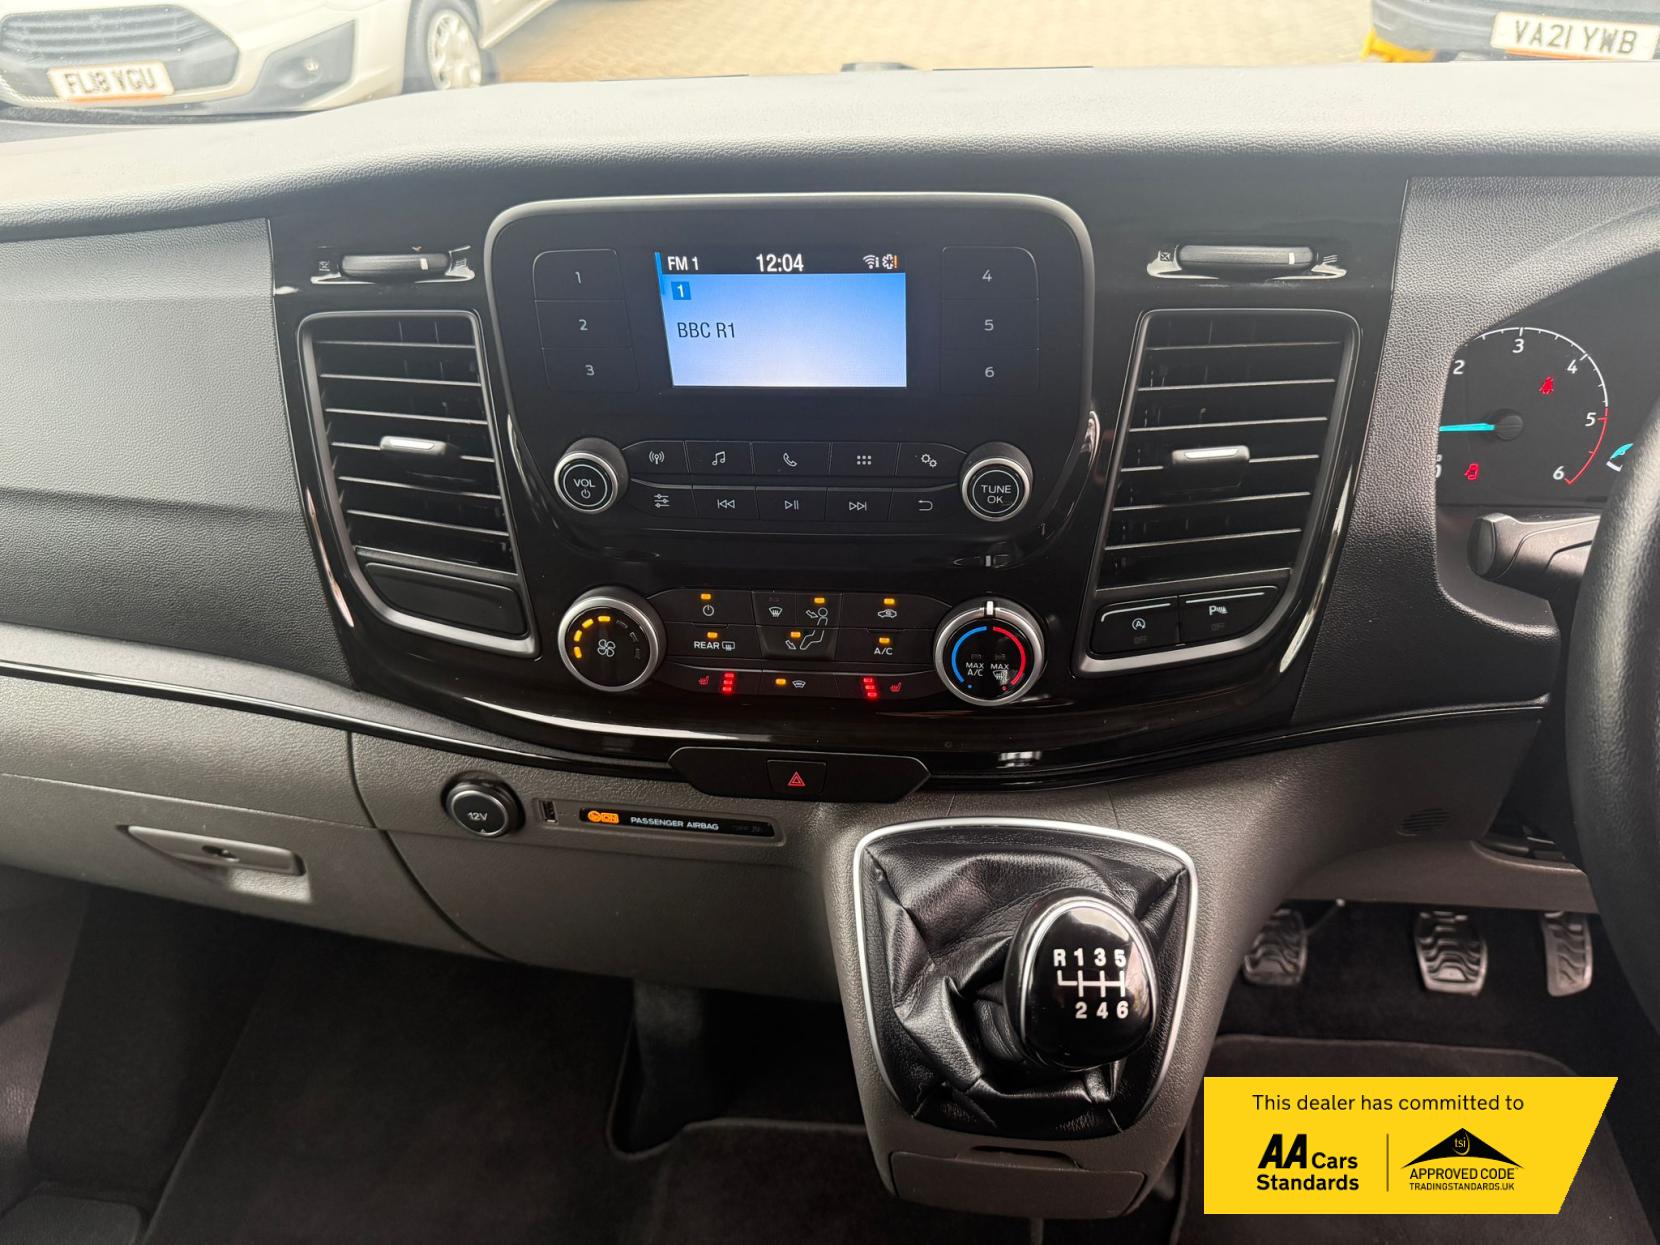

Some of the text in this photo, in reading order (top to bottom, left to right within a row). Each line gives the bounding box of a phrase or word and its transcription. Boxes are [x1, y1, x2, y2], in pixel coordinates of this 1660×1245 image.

[1515, 19, 1638, 55] VA21 YWB
[667, 255, 700, 271] FM 1
[756, 253, 804, 272] 12:04
[575, 271, 582, 284] 1
[982, 269, 993, 282] 4
[677, 283, 685, 299] 1
[578, 318, 588, 331] 2
[677, 322, 735, 339] BBC R1
[984, 319, 994, 332] 5
[1512, 338, 1525, 354] 3
[585, 364, 595, 376] 3
[984, 366, 995, 378] 6
[1451, 358, 1465, 375] 2
[1565, 358, 1579, 375] 4
[1585, 411, 1597, 427] 5
[1552, 465, 1565, 481] 6
[573, 477, 598, 490] VOL
[981, 484, 1012, 494] TUNE
[987, 495, 1004, 504] OK
[693, 640, 720, 651] REAR
[873, 646, 894, 656] A/C
[965, 661, 1010, 671] MAX MAX
[967, 668, 984, 677] A/C
[468, 811, 488, 821] 12V
[630, 816, 719, 831] PASSENGER AIRBAG
[1053, 948, 1127, 967] R 1 3 5
[1075, 1000, 1129, 1019] 2 4 6
